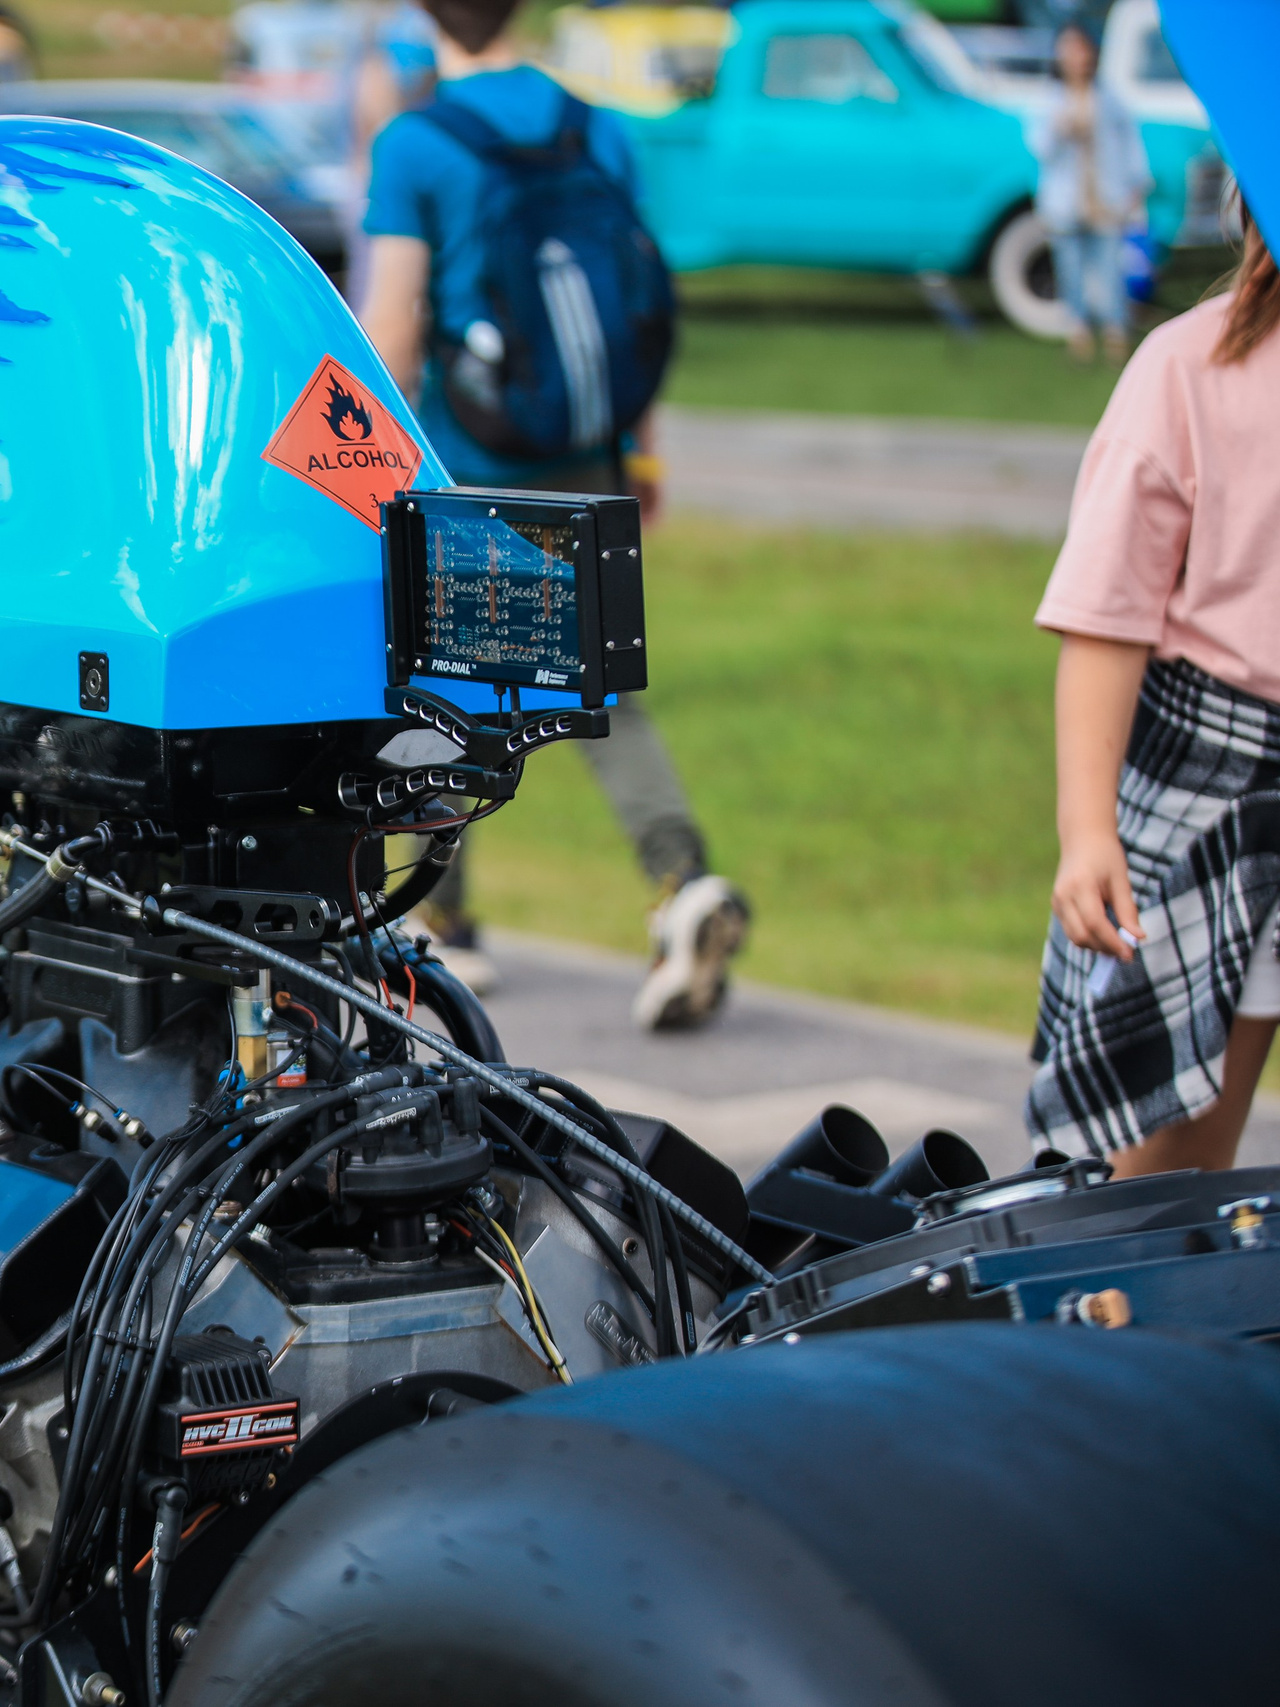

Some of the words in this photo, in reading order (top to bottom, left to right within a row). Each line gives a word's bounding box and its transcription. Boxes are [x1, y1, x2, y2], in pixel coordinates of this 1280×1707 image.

[307, 450, 409, 472] ALCOHOL
[369, 493, 379, 508] 3
[182, 1424, 226, 1441] HVC
[219, 1413, 262, 1443] II
[251, 1415, 296, 1435] COIL
